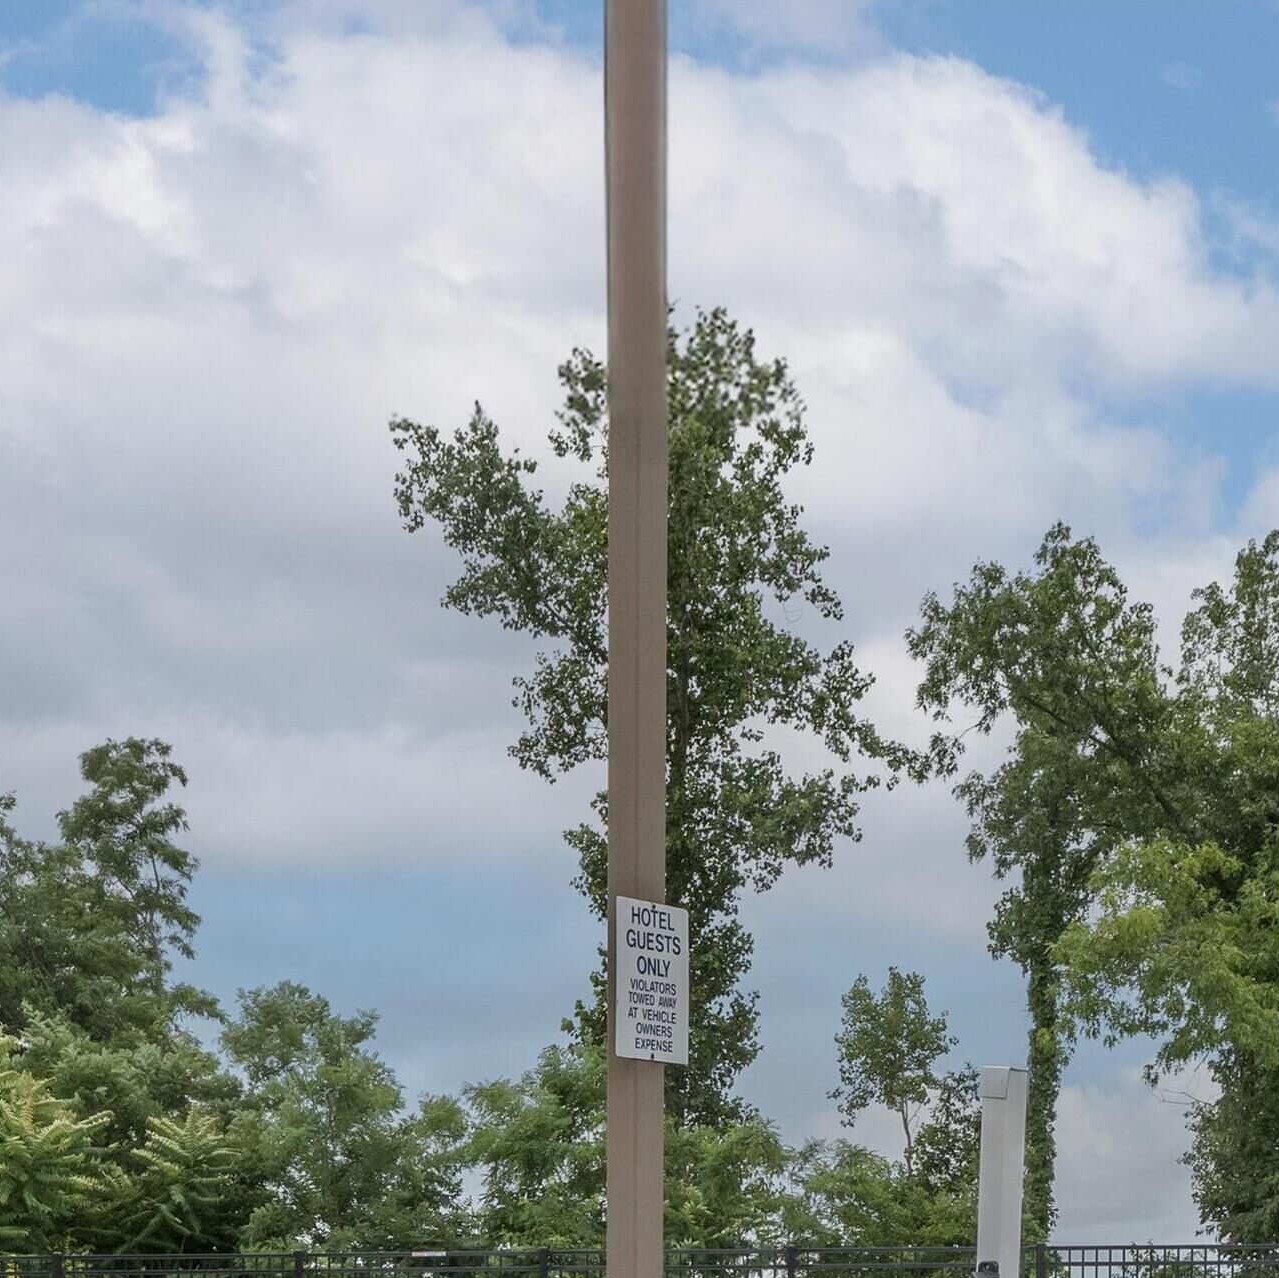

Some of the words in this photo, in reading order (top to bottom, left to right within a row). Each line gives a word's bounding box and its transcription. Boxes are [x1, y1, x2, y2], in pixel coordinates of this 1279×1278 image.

[631, 906, 675, 932] HOTEL
[626, 929, 681, 955] GUESTS
[637, 955, 671, 978] ONLY
[630, 978, 677, 995] VIOLATORS
[628, 991, 655, 1006] TOWED
[658, 997, 677, 1009] AWAY
[628, 1007, 638, 1019] AT
[642, 1008, 677, 1024] VEHICLE
[636, 1022, 672, 1038] OWNERS
[635, 1037, 673, 1053] EXPENSE
